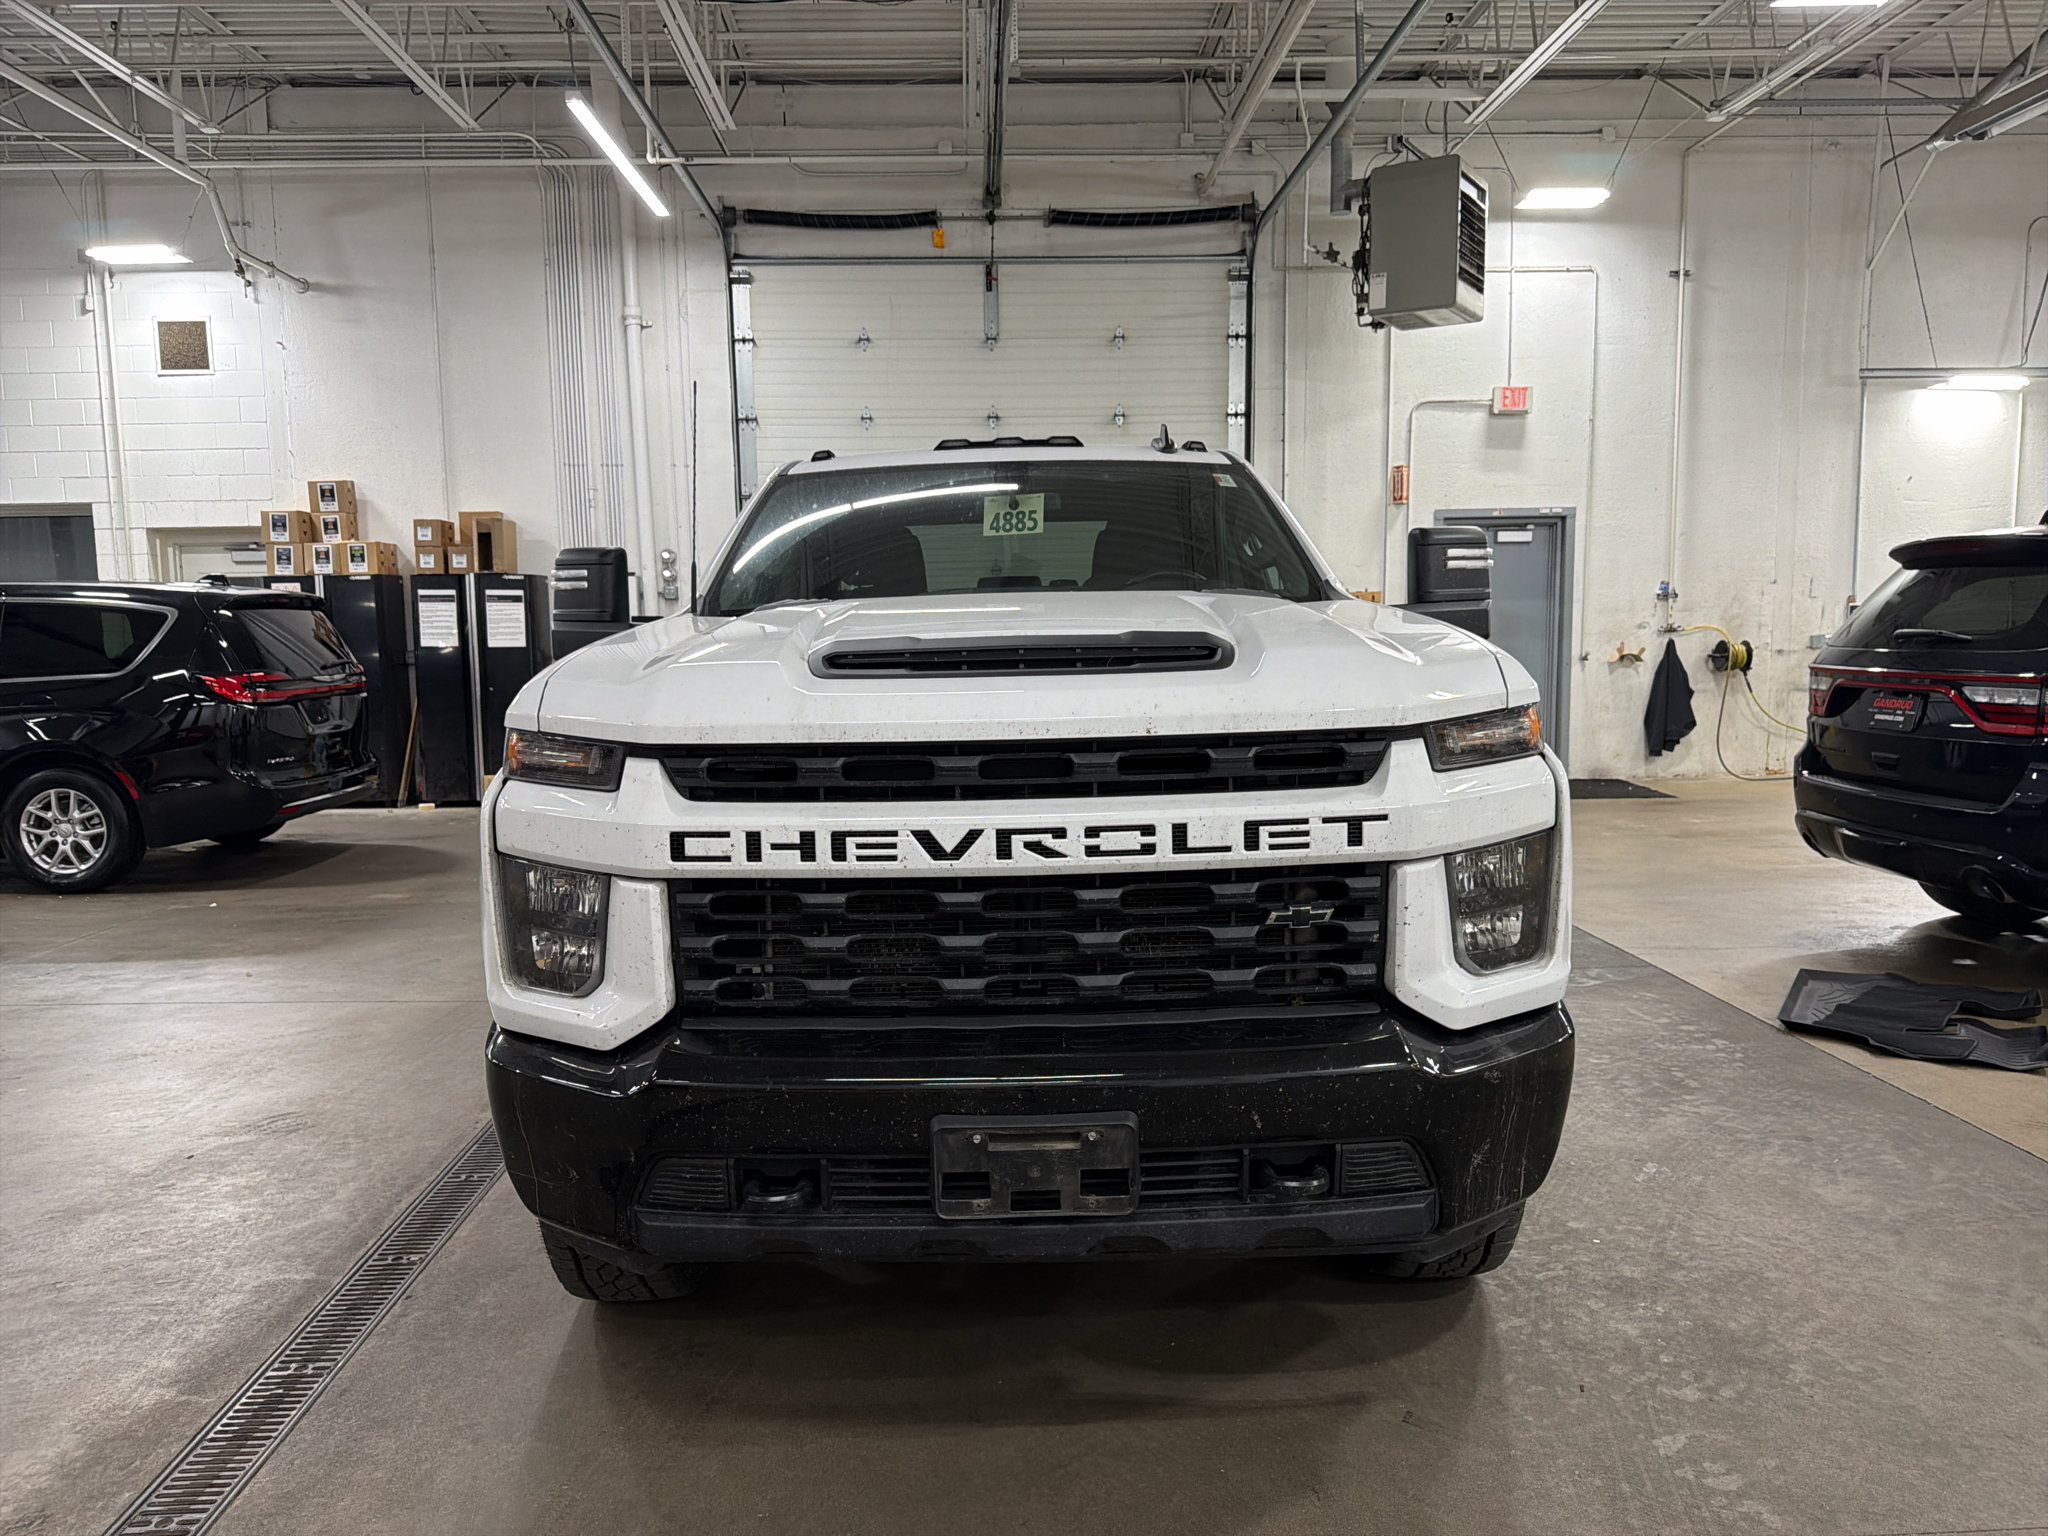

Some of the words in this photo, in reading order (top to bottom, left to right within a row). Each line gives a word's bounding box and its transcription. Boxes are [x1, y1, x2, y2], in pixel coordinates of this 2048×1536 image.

[1501, 387, 1528, 408] EXIT
[989, 509, 1039, 533] 4885
[669, 814, 1390, 864] CHEVROLET
